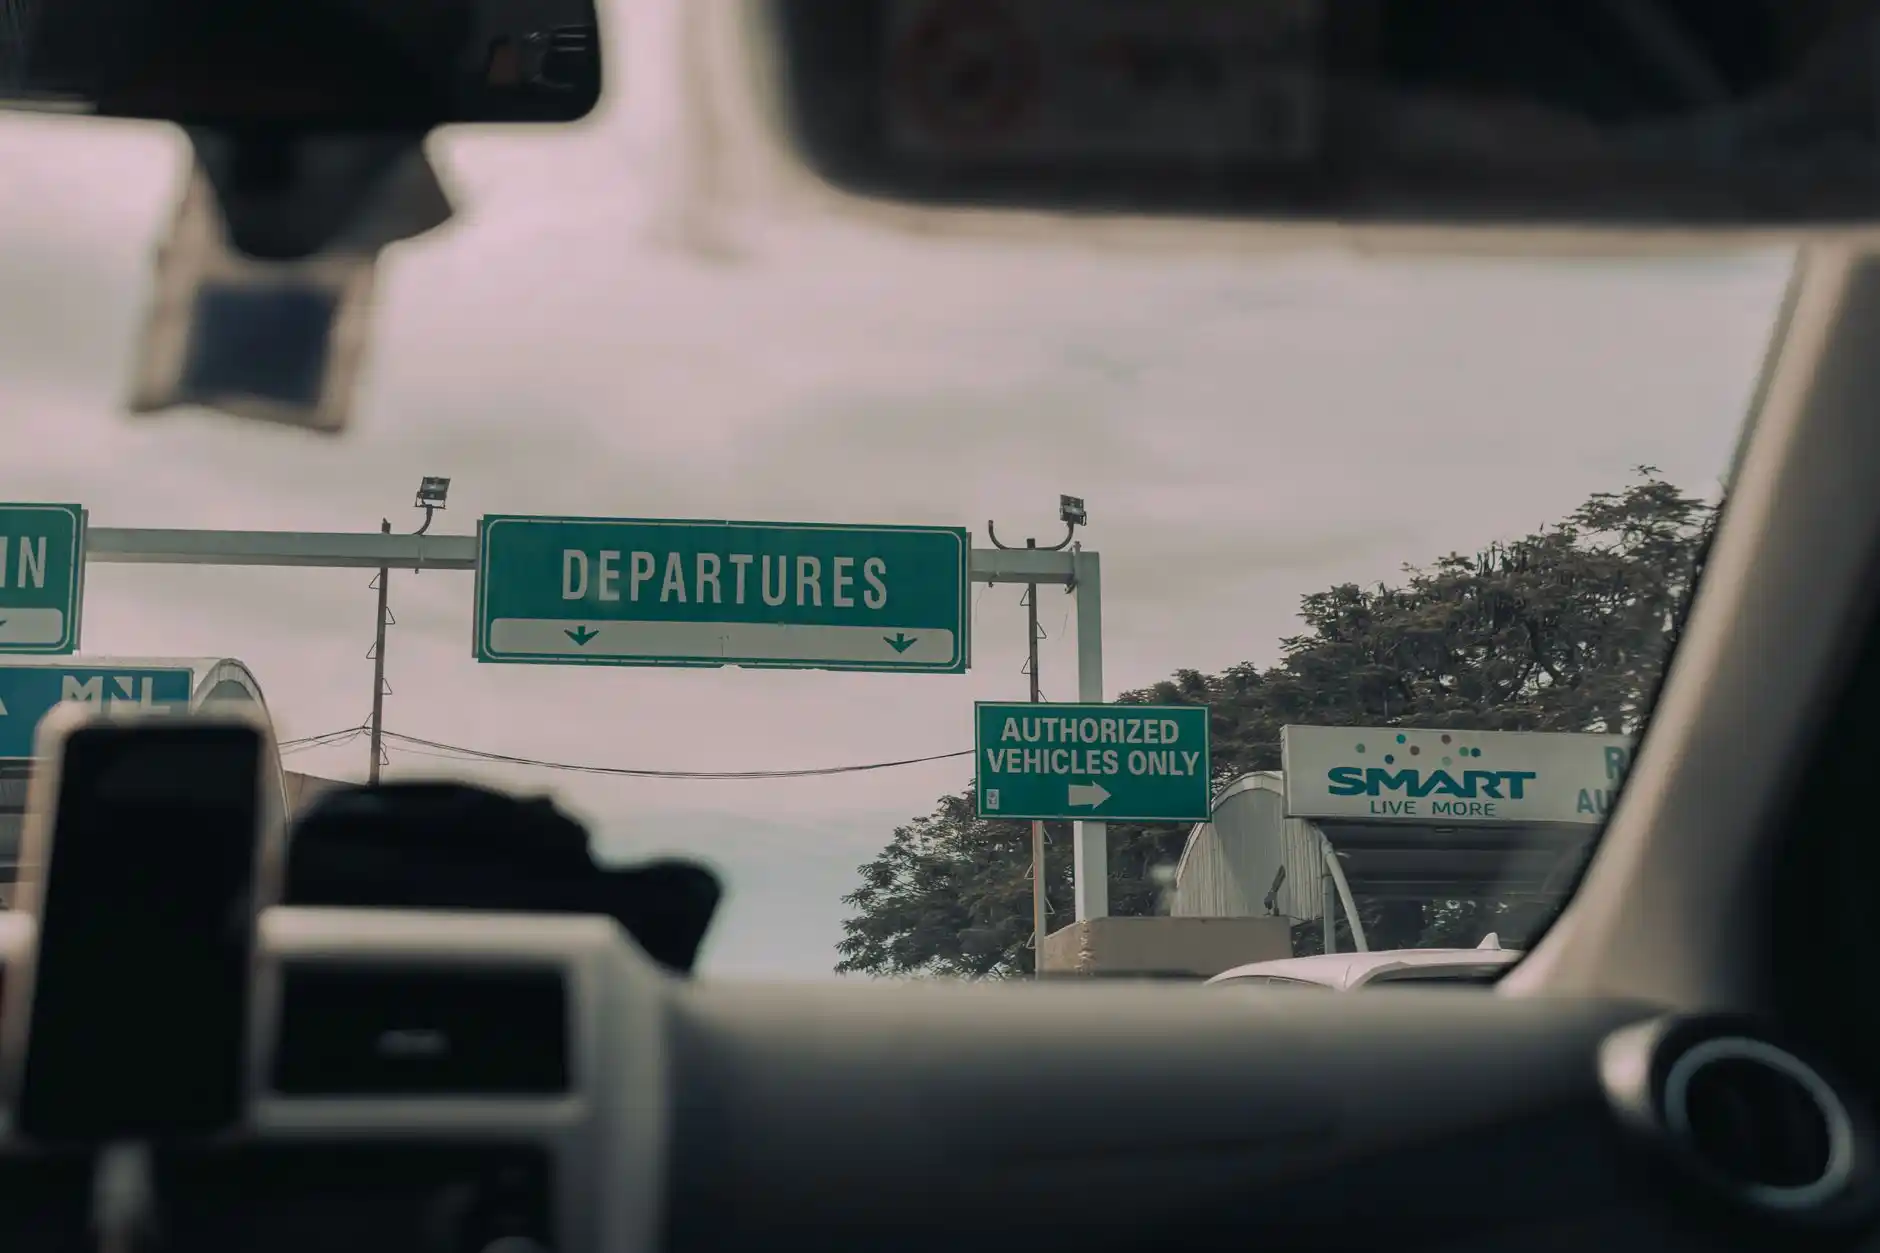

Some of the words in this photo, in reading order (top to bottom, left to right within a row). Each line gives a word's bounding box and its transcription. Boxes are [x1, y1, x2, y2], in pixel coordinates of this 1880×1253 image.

[561, 549, 887, 610] DEPARTURES
[60, 675, 171, 715] MNL
[1001, 717, 1179, 744] AUTHORIZED
[986, 749, 1119, 775] VEHICLES
[1127, 750, 1200, 776] ONLY
[1328, 766, 1536, 800] SMART
[1370, 800, 1416, 815] LIVE
[1432, 801, 1496, 816] MORE
